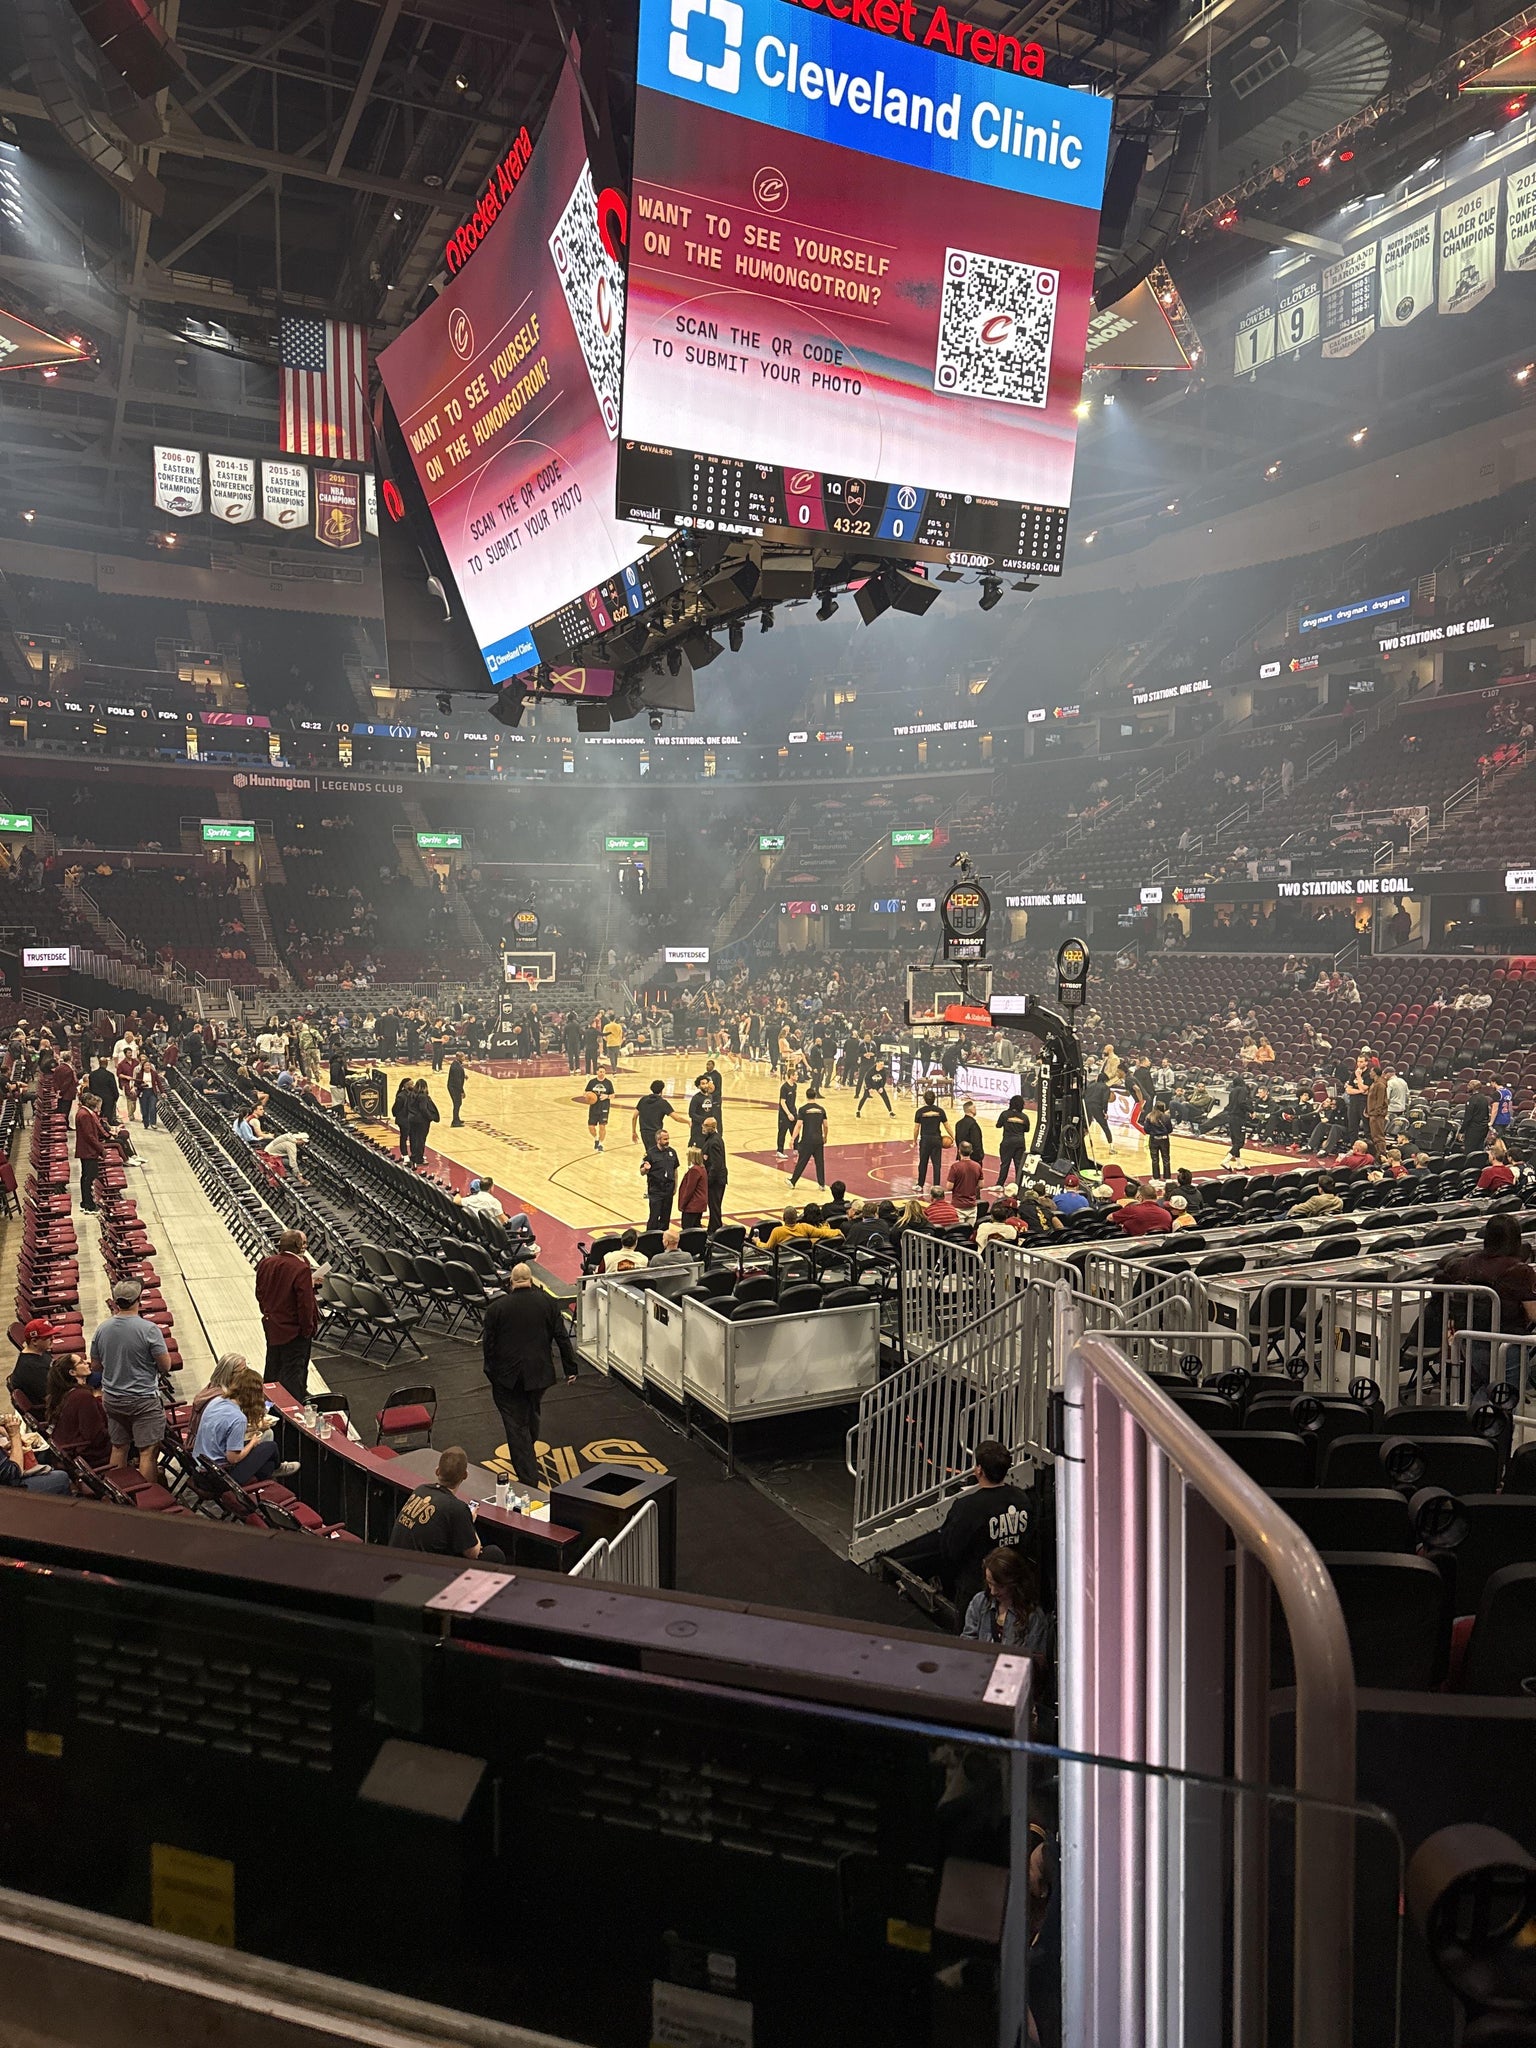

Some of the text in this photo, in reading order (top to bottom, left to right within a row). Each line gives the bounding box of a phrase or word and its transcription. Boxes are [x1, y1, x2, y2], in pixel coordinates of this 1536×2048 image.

[923, 6, 1045, 78] Arena
[755, 35, 1082, 170] Cleveland Clinic
[455, 125, 533, 261] Rocket Arena
[1457, 196, 1482, 219] 2016
[1405, 224, 1429, 240] DIVISION
[1443, 206, 1495, 244] CALDER CUP
[638, 195, 890, 277] WANT TO SEE YOURSELF
[1443, 223, 1495, 259] CHAMPIONS
[1384, 232, 1430, 264] CHAMPIONS
[644, 231, 881, 306] ON THE HUMONGOTRON?
[1323, 246, 1374, 280] CLEVELAND
[1332, 261, 1366, 285] BARONS
[1280, 283, 1317, 309] GLOVER
[1240, 307, 1271, 329] BOWER
[1291, 307, 1304, 343] 9
[676, 316, 843, 366] SCAN THE QR CODE
[1249, 328, 1258, 364] 1
[652, 338, 862, 395] TO SUBMIT YOUR PHOTO
[409, 313, 540, 454] WANT TO SEE YOURSELF
[425, 356, 550, 482] ON THE HUMONGOTRON?
[640, 444, 673, 456] CAVALIERS
[161, 452, 196, 464] 2006-07
[163, 463, 195, 475] EASTERN
[215, 460, 249, 472] 2014-15
[269, 466, 301, 477] 2015-16
[755, 464, 773, 472] FOULS
[157, 472, 201, 485] CONFERENCE
[217, 471, 247, 482] EASTERN
[270, 477, 300, 488] EASTERN
[328, 473, 346, 484] 2016
[159, 481, 199, 495] CHAMPIONS
[212, 479, 254, 492] CONFERENCE
[265, 485, 306, 498] CONFERENCE
[330, 486, 344, 496] NBA
[827, 482, 842, 496] 1Q
[214, 488, 252, 501] CHAMPIONS
[267, 496, 304, 507] CHAMPIONS
[319, 493, 356, 506] CHAMPIONS
[470, 460, 561, 540] SCAN THE QR CODE
[935, 492, 952, 500] FOULS
[630, 508, 661, 520] oswald
[799, 505, 810, 524] 0
[468, 483, 582, 575] TO SUBMIT YOUR PHOTO
[718, 522, 764, 537] RAFFLE
[833, 518, 871, 535] 43:22
[892, 519, 903, 538] 0
[950, 552, 989, 567] $10,000
[1003, 559, 1060, 573] CAVS5050.COM
[1388, 595, 1406, 606] mart
[613, 606, 628, 623] 43:22
[1352, 605, 1368, 615] mart
[1317, 614, 1333, 624] mart
[1379, 617, 1494, 652] TWO STATIONS. ONE GOAL.
[1132, 679, 1212, 705] TWO STATIONS. ONE GOAL.
[65, 702, 95, 714] TOL 7
[108, 706, 147, 718] FOULS 0
[186, 712, 193, 721] 0
[246, 717, 253, 726] 0
[301, 721, 349, 733] 43:22 1Q
[367, 725, 374, 735] 0
[893, 719, 978, 736] TWO STATIONS. ONE GOAL.
[444, 732, 450, 740] 0
[464, 733, 487, 741] FOULS
[654, 736, 741, 745] TWO STATIONS. ONE GOAL.
[250, 774, 403, 793] Huntington LEGENDS CLUB
[206, 829, 232, 837] Sprite
[894, 833, 915, 842] Sprite
[419, 836, 442, 845] Sprite
[1278, 877, 1413, 897] TWO STATIONS. ONE GOAL.
[950, 894, 979, 907] 43:22
[1005, 893, 1086, 907] TWO STATIONS. ONE GOAL.
[835, 903, 856, 912] 43:22
[517, 914, 535, 922] 43:22
[27, 953, 67, 961] TRUSTEDSEC
[1064, 951, 1083, 961] 43:22
[1035, 1124, 1046, 1148] Clinic
[988, 1505, 1028, 1540] CAVS
[998, 1534, 1020, 1548] CREW
